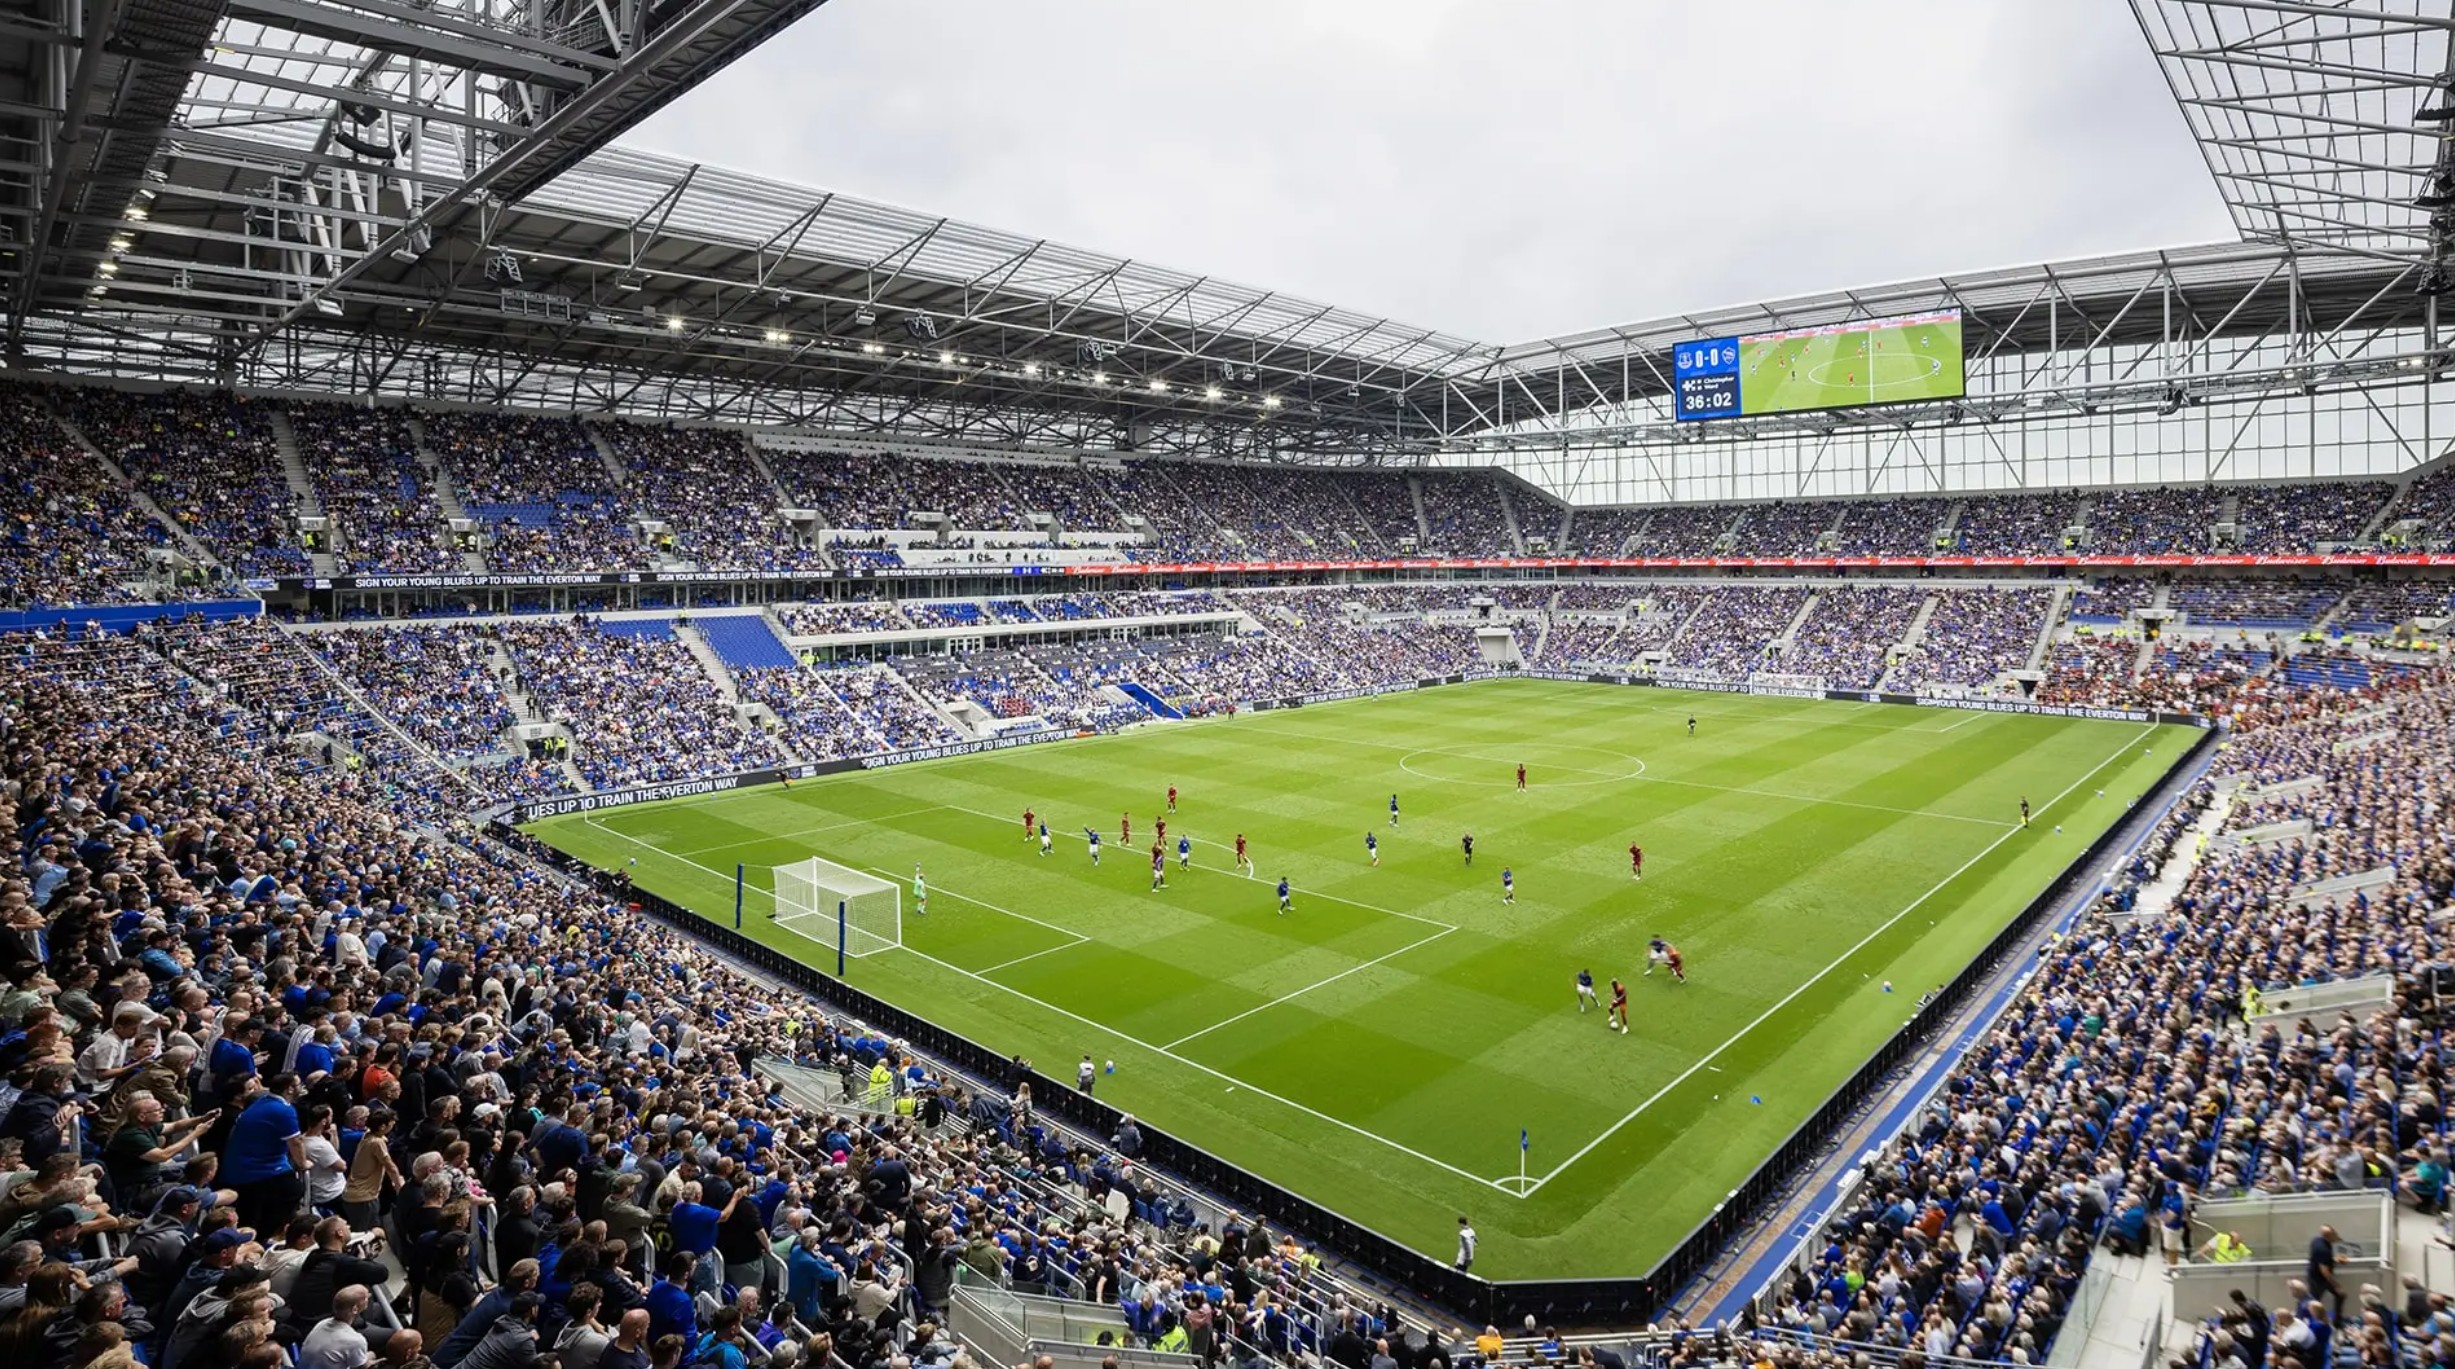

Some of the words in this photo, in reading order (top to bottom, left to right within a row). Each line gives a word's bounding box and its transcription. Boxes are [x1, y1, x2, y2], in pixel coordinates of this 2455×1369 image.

[1695, 348, 1719, 368] 0-0
[1686, 392, 1732, 410] 36:02
[2078, 556, 2123, 565] Budweiser
[2134, 556, 2182, 565] Budweiser
[2193, 556, 2244, 565] Budweiser
[2255, 556, 2309, 565] Budweiser
[2376, 556, 2419, 564] Budweiser
[356, 579, 379, 588] SIGN
[382, 578, 408, 587] YOUR
[409, 577, 442, 586] YOUNG
[444, 577, 473, 586] BLUES
[475, 576, 488, 585] UP
[490, 576, 500, 585] TO
[502, 576, 528, 585] TRAIN
[529, 575, 544, 584] THE
[546, 574, 583, 584] EVERTON
[584, 574, 601, 583] WAY
[1958, 701, 1986, 710] YOUNG
[1987, 702, 2014, 712] BLUES
[2015, 704, 2028, 712] UP
[2028, 705, 2040, 713] TO
[2041, 706, 2066, 715] TRAIN
[2067, 707, 2084, 716] THE
[2086, 709, 2127, 718] EVERTON
[2128, 711, 2148, 720] WAY
[886, 753, 911, 764] YOUR
[912, 749, 941, 761] YOUNG
[943, 745, 970, 756] BLUES
[970, 742, 983, 753] UP
[984, 741, 994, 751] TO
[994, 738, 1017, 749] TRAIN
[1018, 735, 1031, 746] THE
[529, 803, 555, 818] UES
[558, 800, 576, 814] UP
[596, 792, 634, 809] TRAIN
[635, 788, 660, 803] THE
[714, 777, 738, 790] WAY
